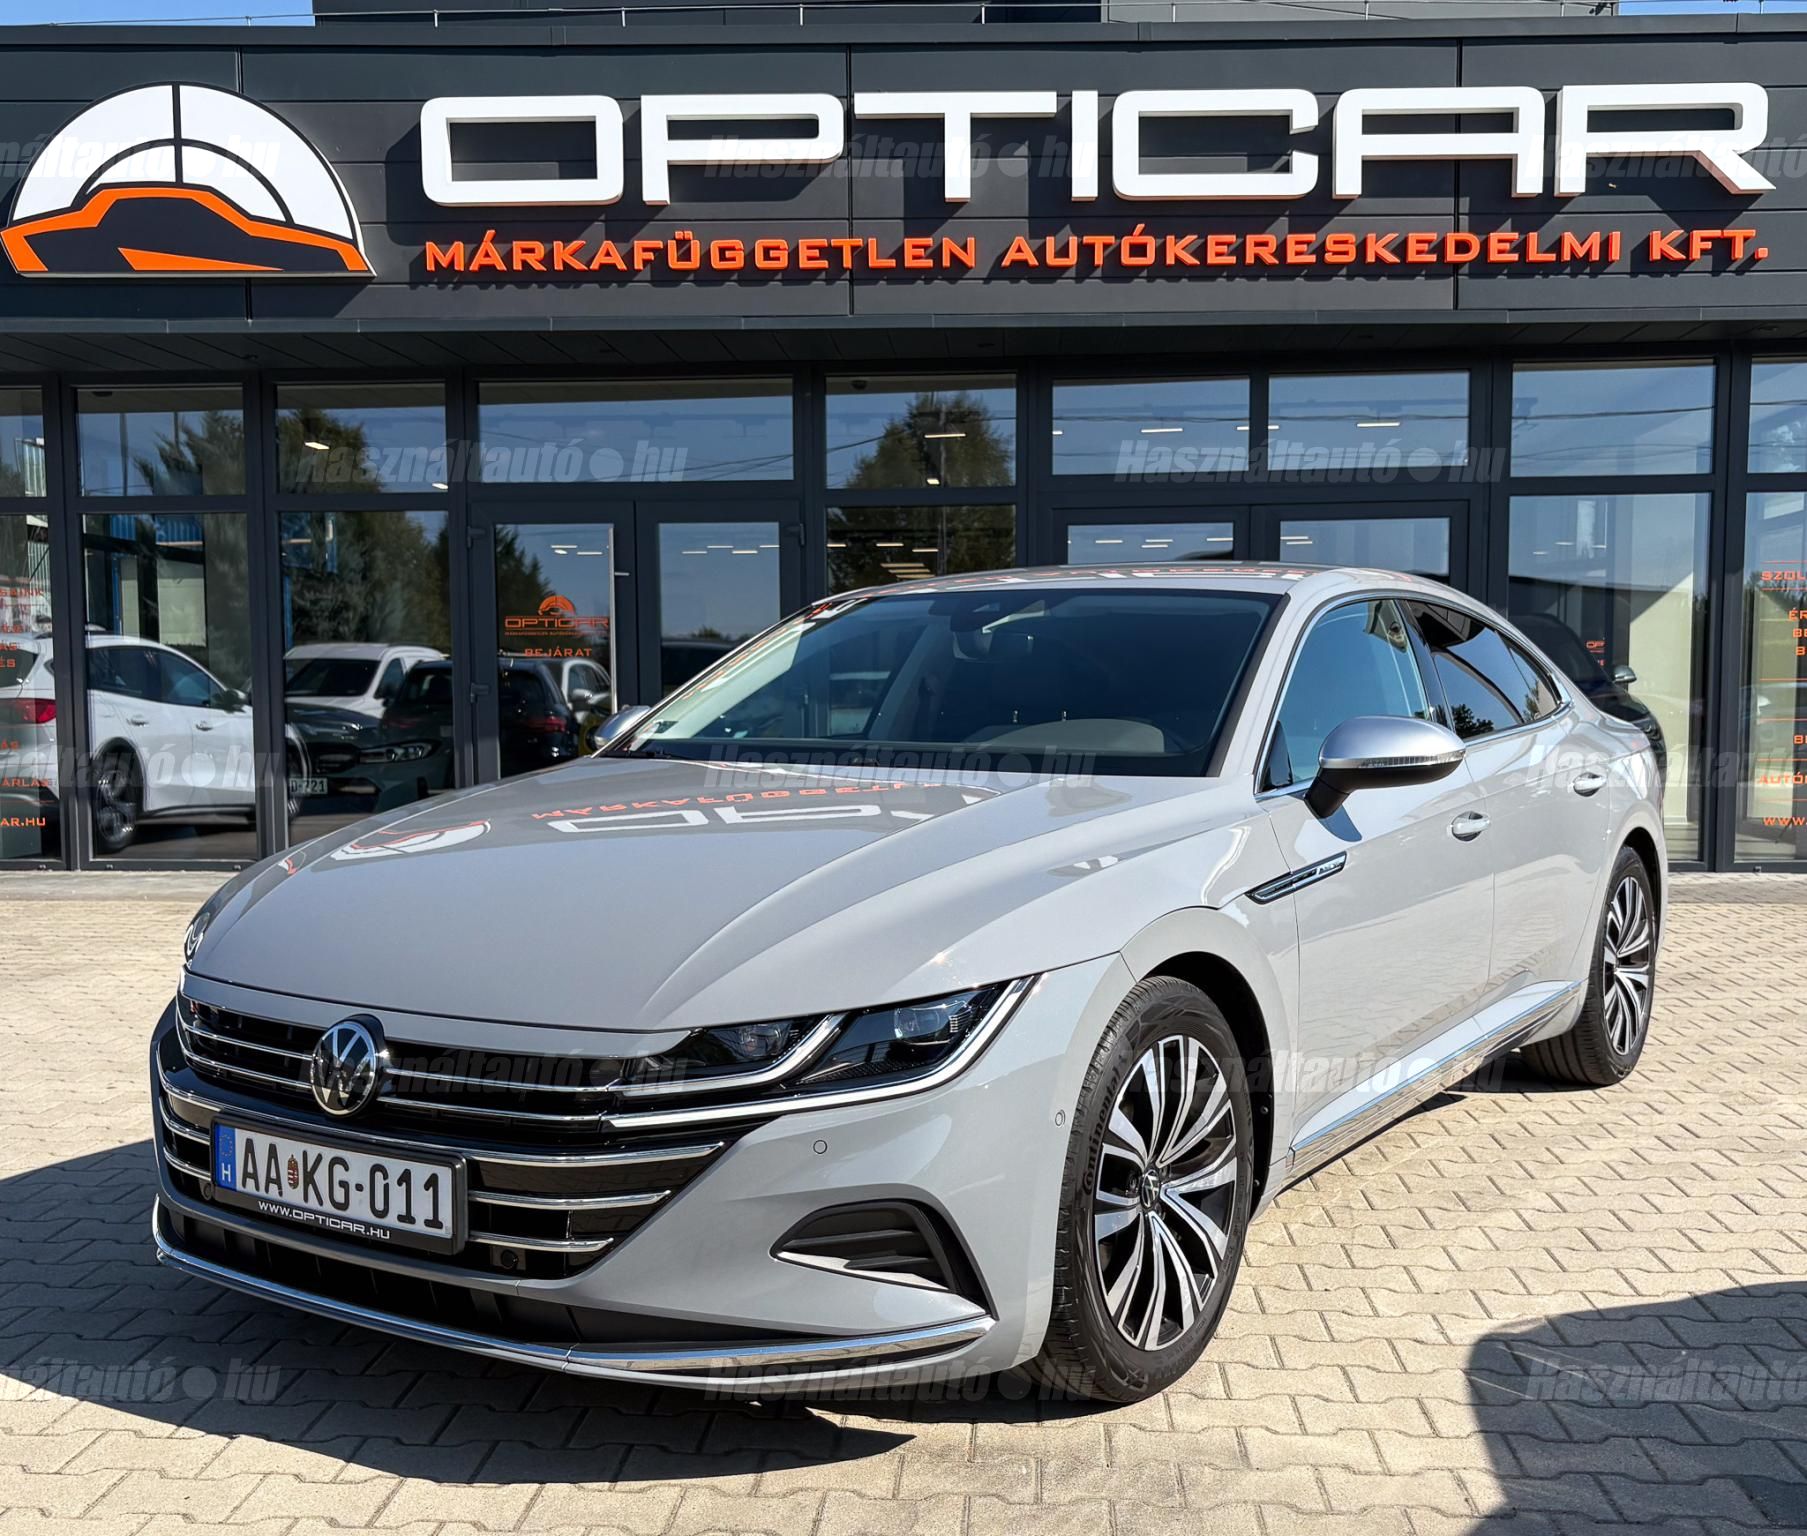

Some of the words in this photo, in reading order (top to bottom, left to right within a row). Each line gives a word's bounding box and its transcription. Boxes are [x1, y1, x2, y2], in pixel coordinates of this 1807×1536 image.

[421, 82, 1776, 207] OPTICAR
[425, 230, 975, 272] MÁRKAFÜGGETLEN
[1001, 223, 1622, 269] AUTÓKERESKEDELMI
[1649, 227, 1769, 264] KFT.
[504, 618, 609, 629] OPTICAR
[524, 646, 592, 657] BEJÁRAT
[221, 1163, 231, 1182] H
[258, 1200, 390, 1240] WWW.OPTICAR.HU
